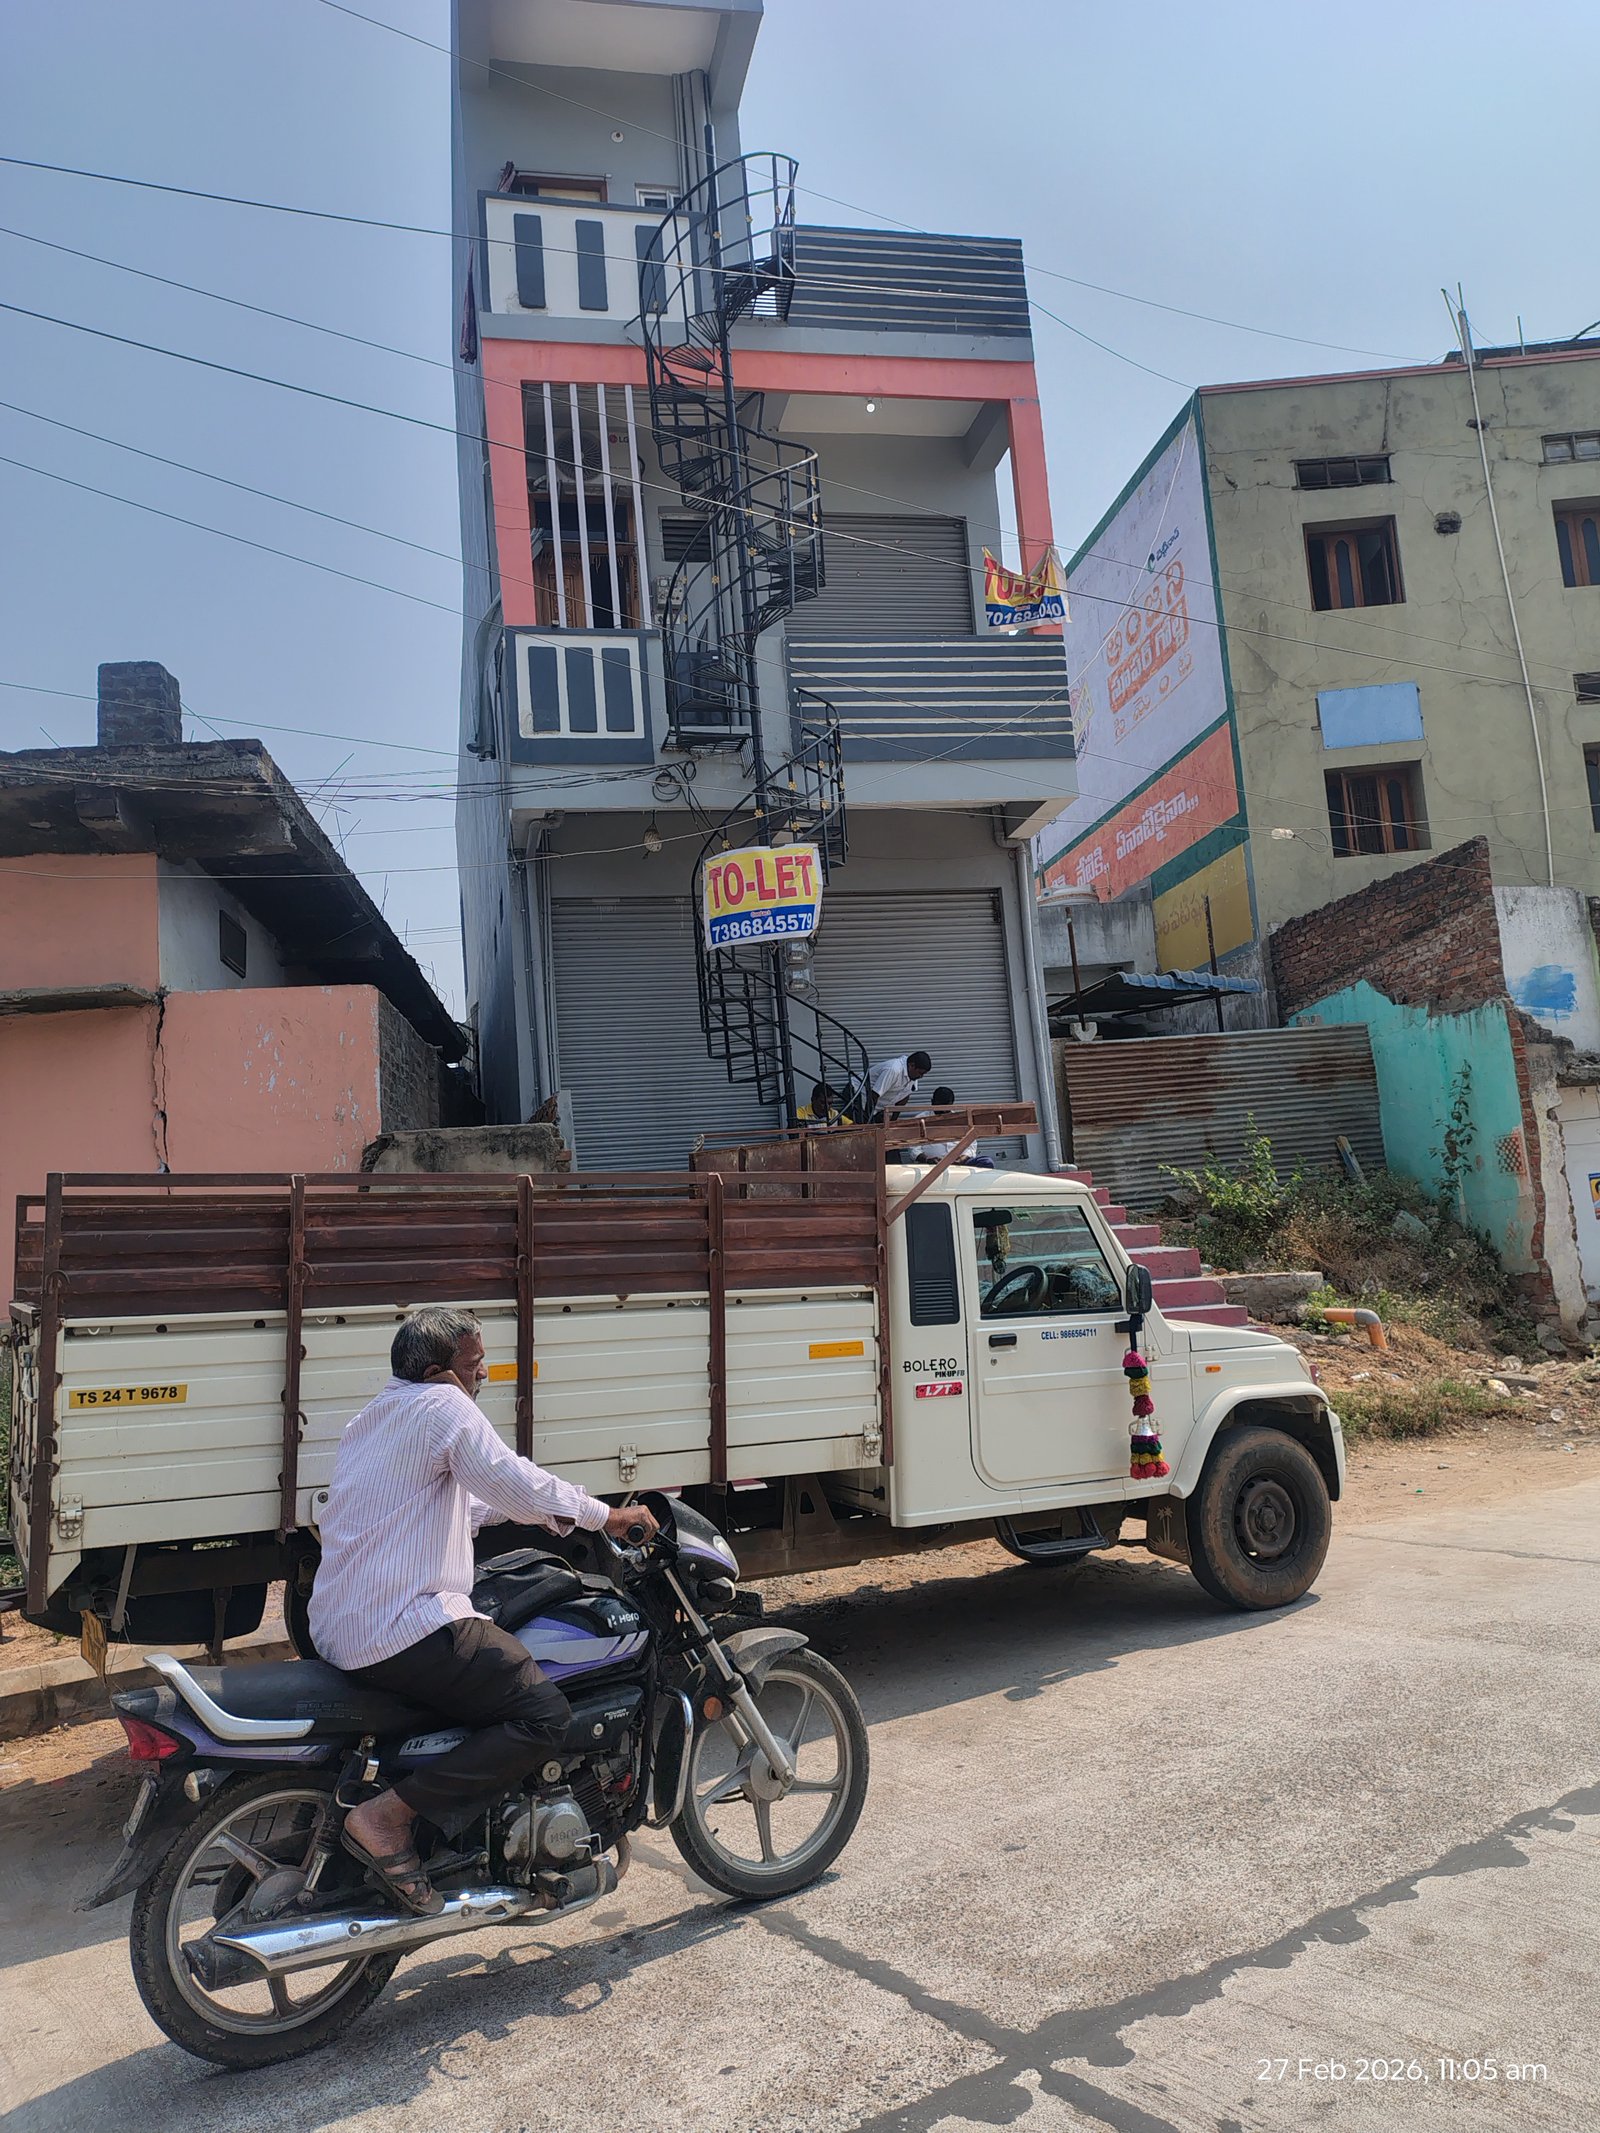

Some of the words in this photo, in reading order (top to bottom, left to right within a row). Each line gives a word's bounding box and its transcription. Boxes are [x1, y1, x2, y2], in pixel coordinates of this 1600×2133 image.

[709, 855, 813, 909] TO-LET
[712, 912, 813, 942] 7386845579
[1041, 1331, 1059, 1340] CELL:
[1060, 1328, 1097, 1339] 9866564711
[903, 1358, 957, 1373] BOLERO
[77, 1392, 98, 1404] TS
[103, 1390, 121, 1402] 24
[126, 1389, 136, 1400] T
[141, 1387, 178, 1400] 9678
[618, 1612, 640, 1624] Hero
[406, 1738, 429, 1750] HF
